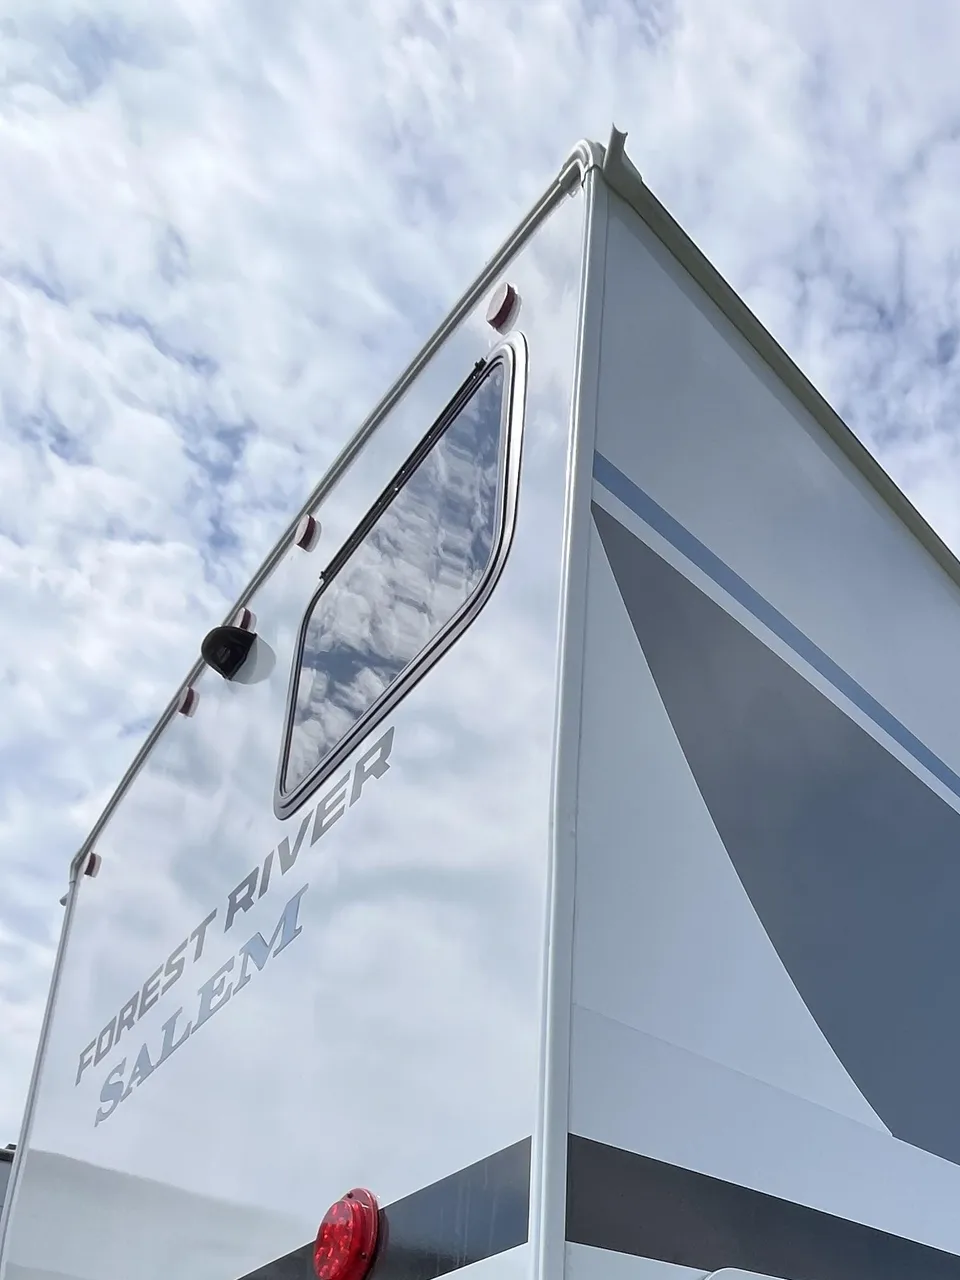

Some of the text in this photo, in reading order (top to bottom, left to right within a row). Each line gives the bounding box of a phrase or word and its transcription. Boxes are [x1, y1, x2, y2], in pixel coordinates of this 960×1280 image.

[75, 725, 395, 1087] FOREST RIVER
[94, 882, 310, 1128] SALEM
